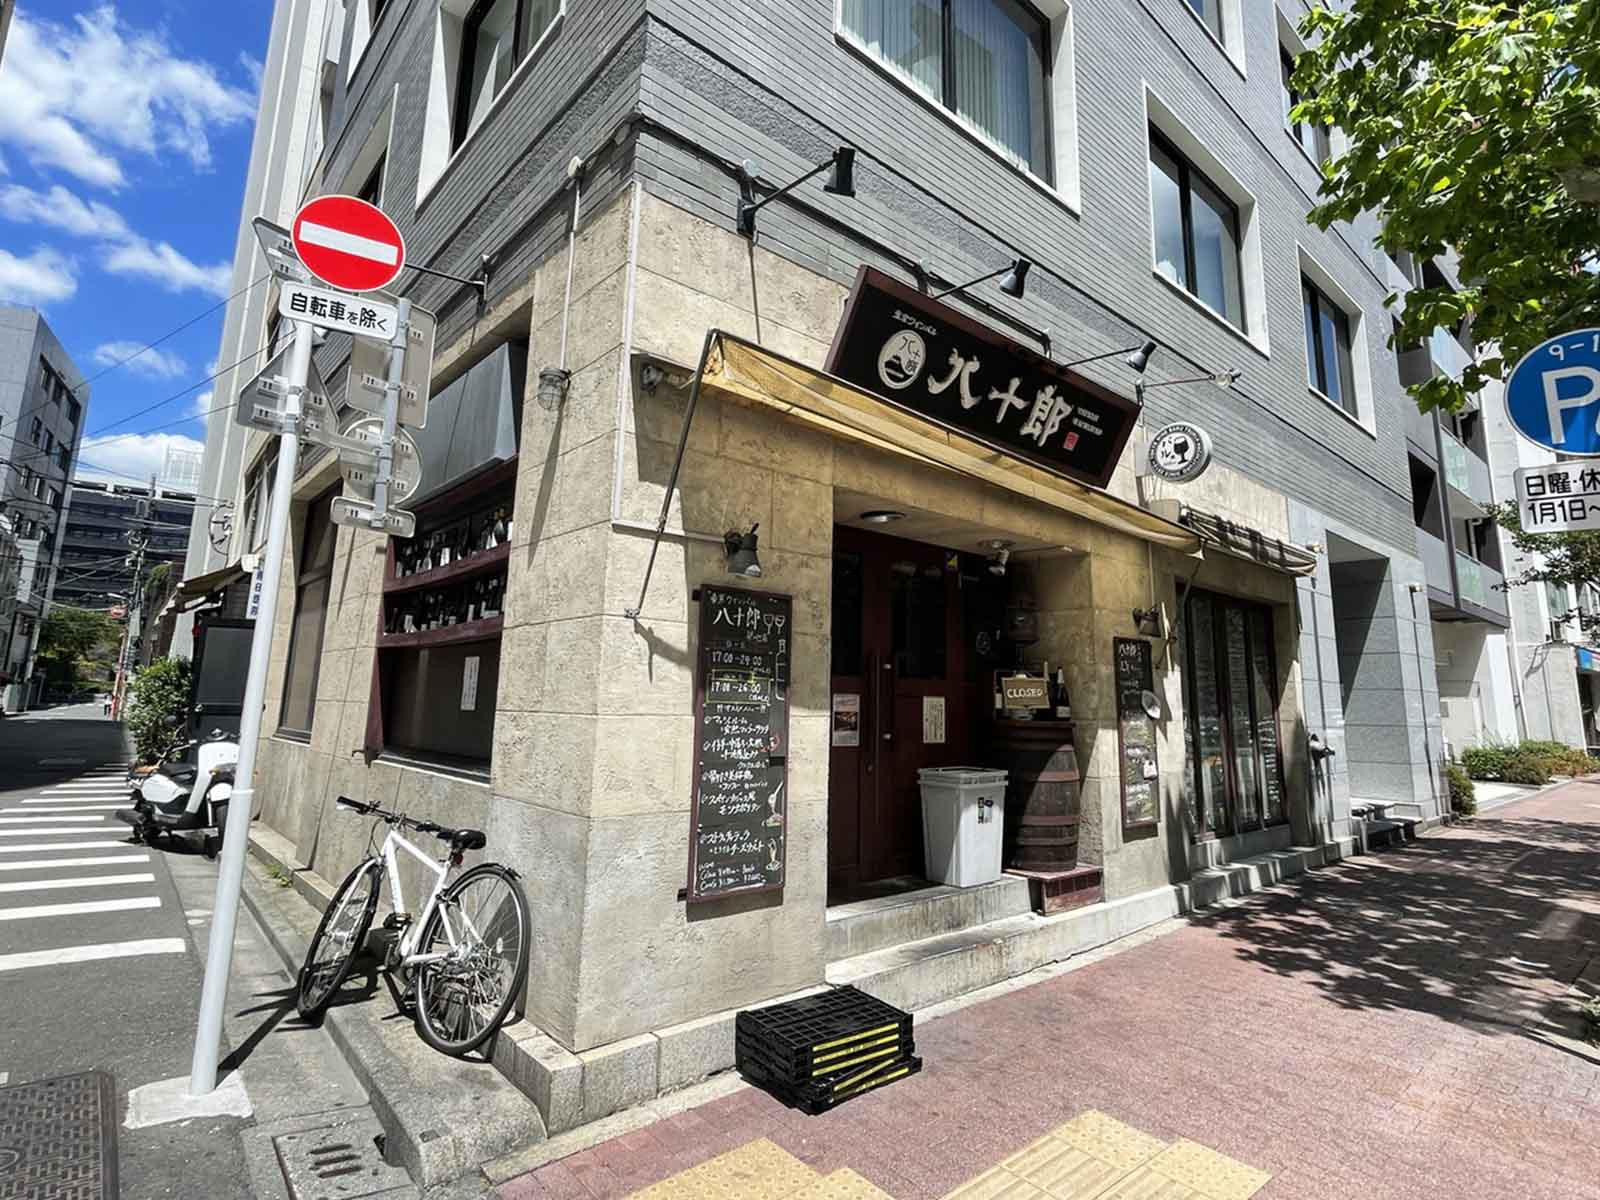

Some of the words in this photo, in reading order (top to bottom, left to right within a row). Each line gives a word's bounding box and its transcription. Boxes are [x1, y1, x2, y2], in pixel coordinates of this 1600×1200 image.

[290, 292, 387, 332] 自転車を除く
[927, 347, 1074, 447] 八十郎
[712, 606, 761, 630] 八十郎
[1007, 687, 1044, 699] CLOSED
